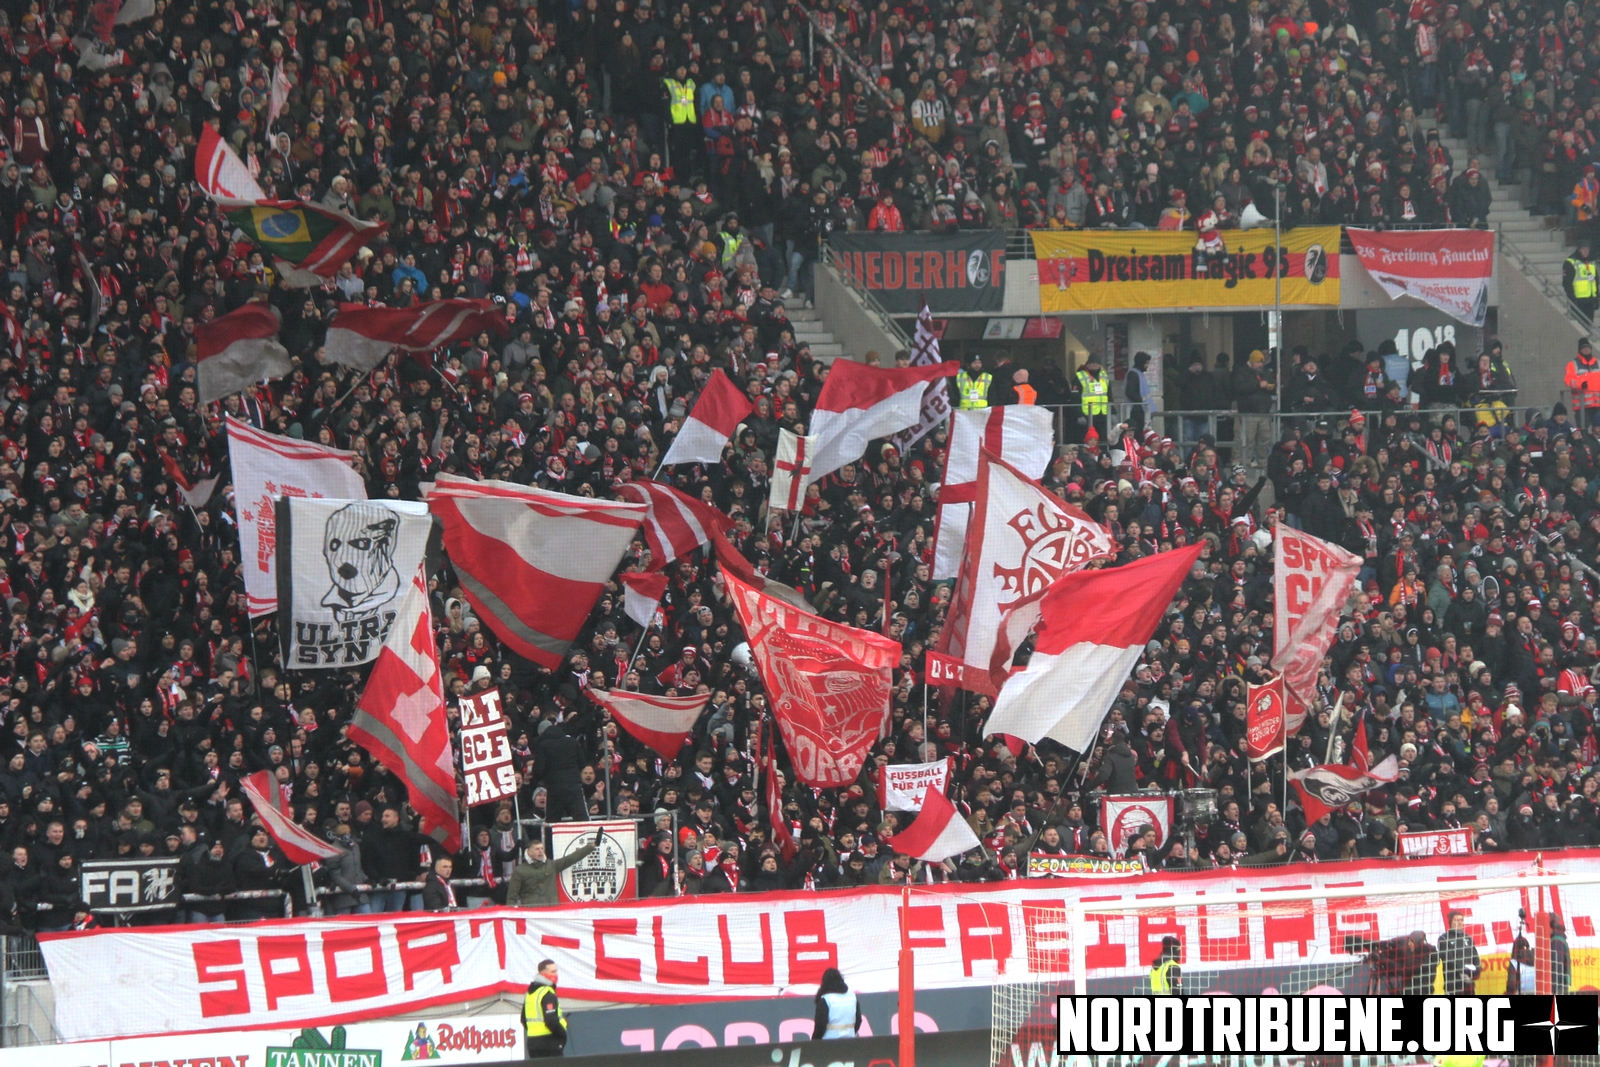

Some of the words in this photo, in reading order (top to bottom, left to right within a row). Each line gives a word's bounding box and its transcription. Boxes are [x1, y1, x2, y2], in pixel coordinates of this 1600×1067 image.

[1087, 247, 1185, 283] Dreisam
[1262, 246, 1289, 279] 95
[1379, 247, 1438, 265] Freiburg
[463, 731, 507, 764] SCF
[465, 764, 517, 805] RAS
[890, 768, 943, 780] FUSSBALL
[892, 782, 914, 791] FÜR
[916, 778, 942, 789] ALLE
[1091, 860, 1139, 873] VOLTS
[82, 870, 140, 905] FA
[436, 1023, 517, 1055] Rothaus
